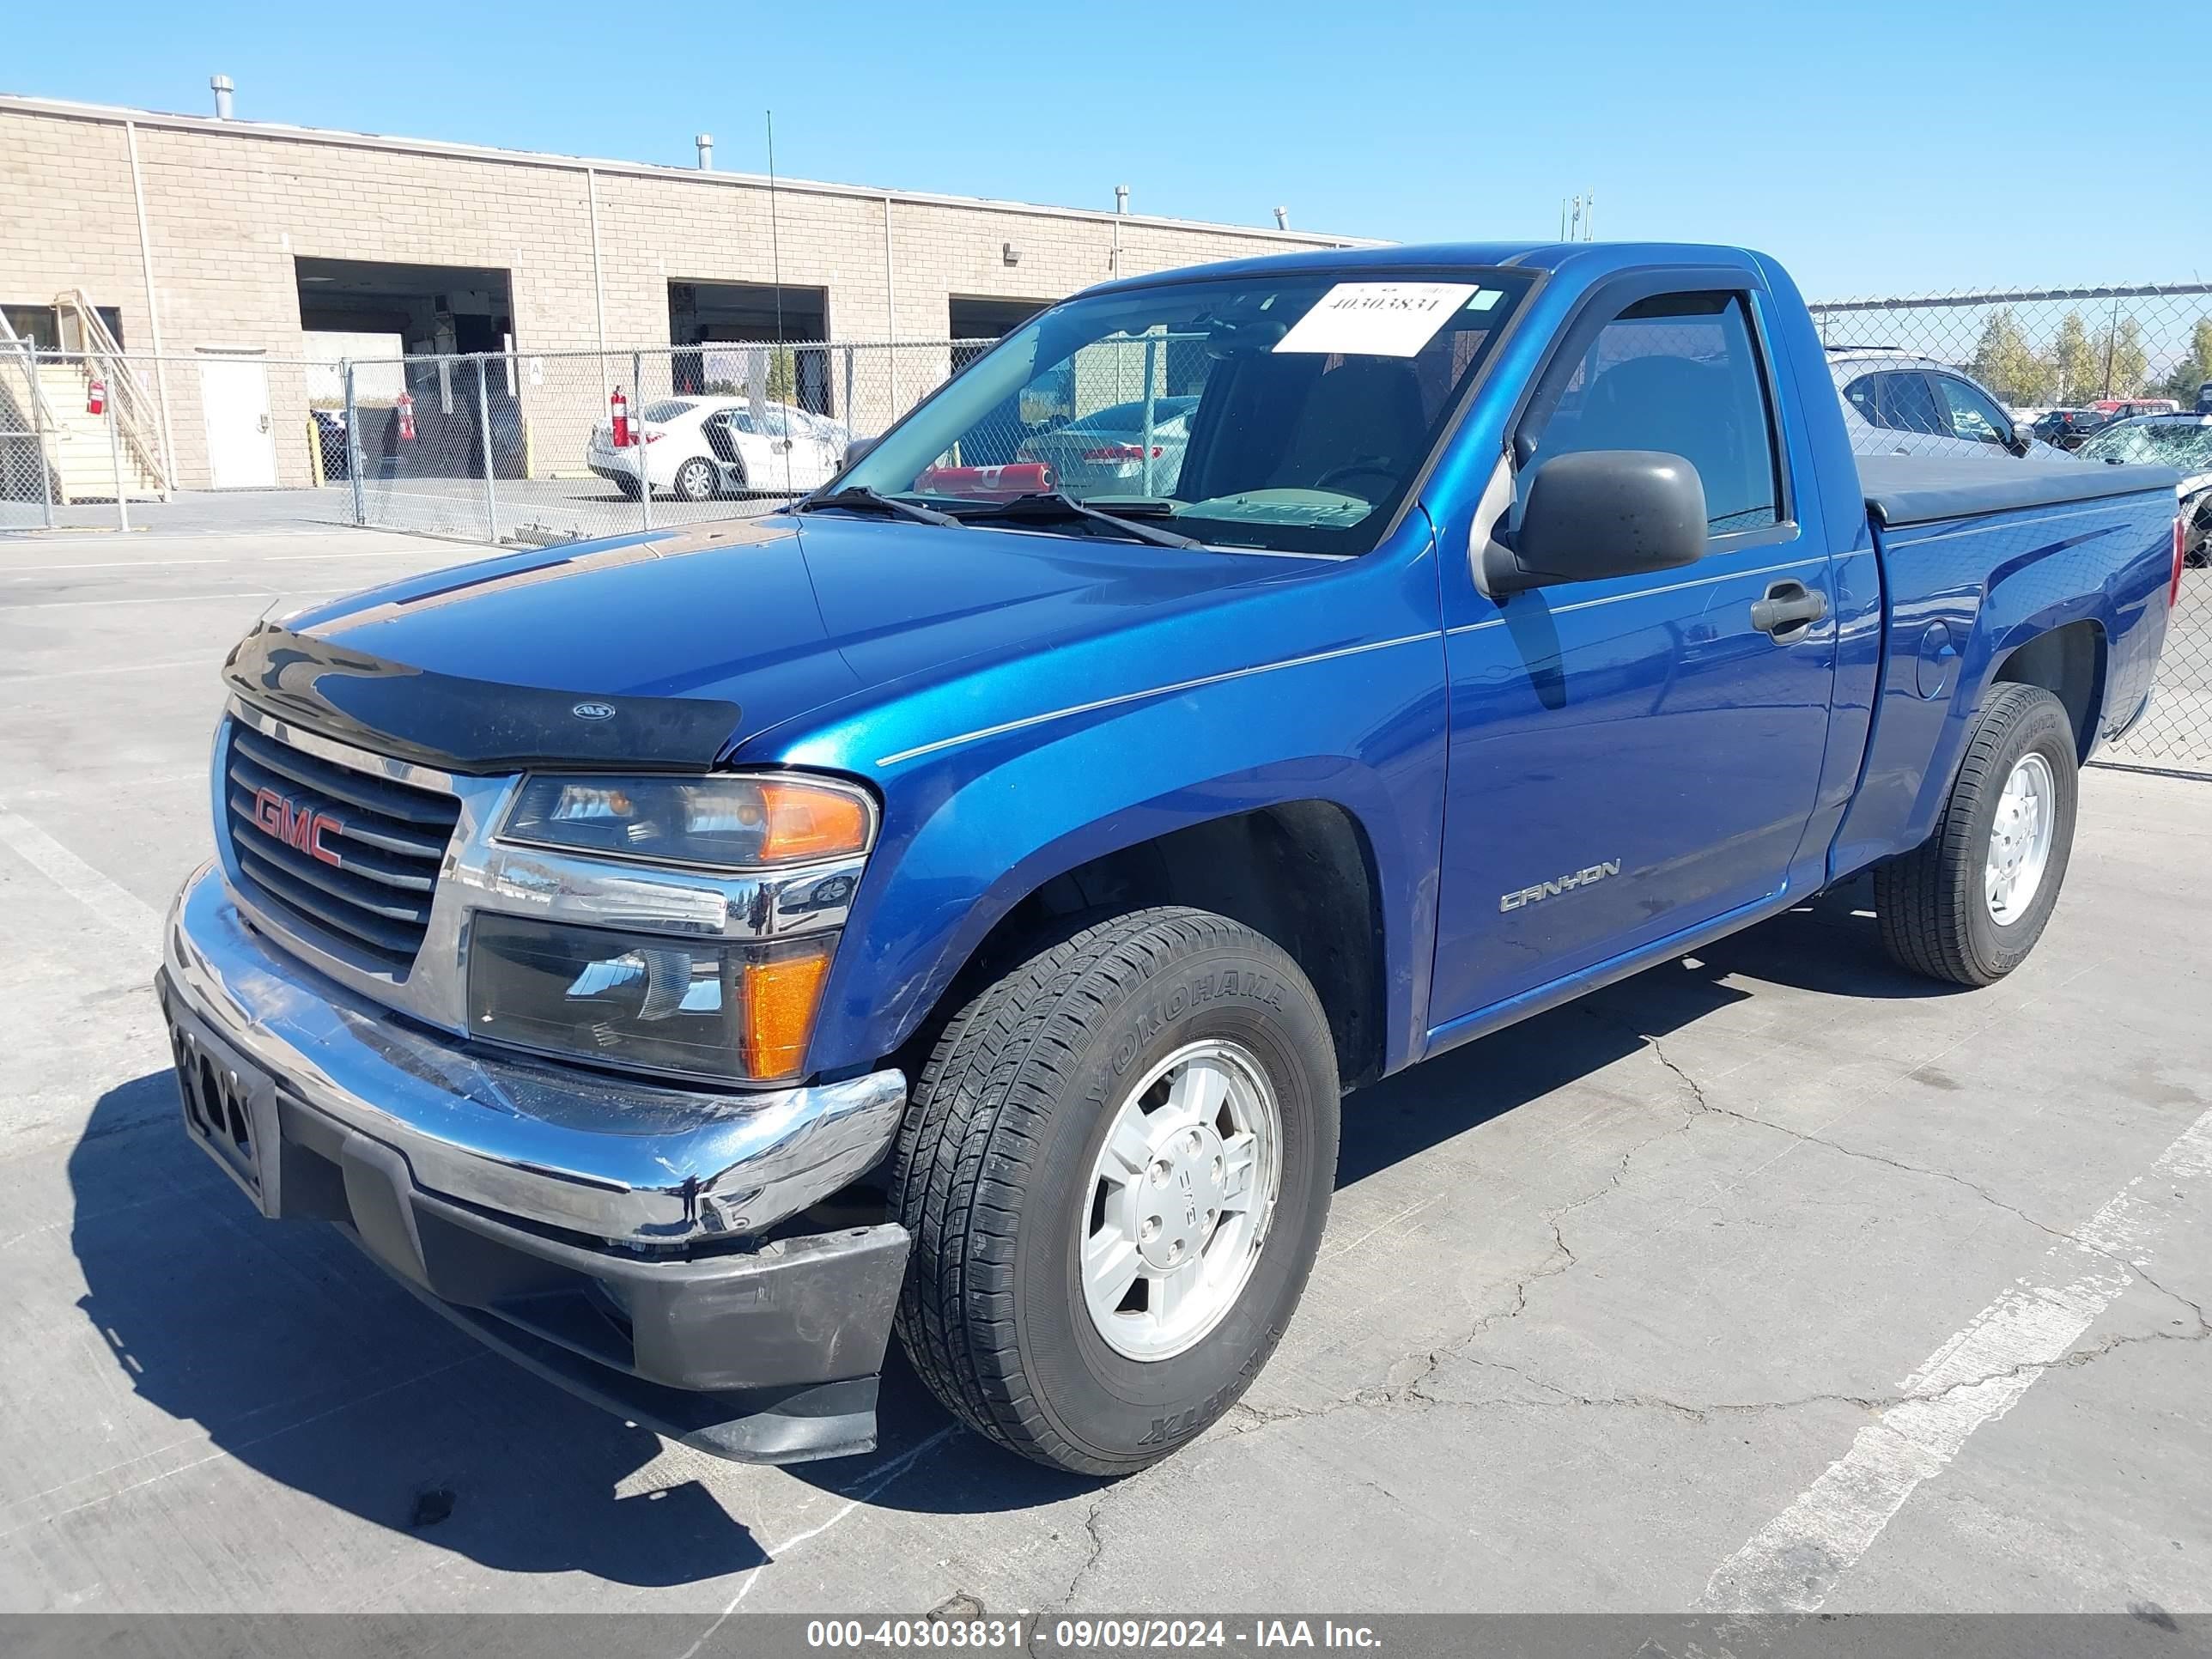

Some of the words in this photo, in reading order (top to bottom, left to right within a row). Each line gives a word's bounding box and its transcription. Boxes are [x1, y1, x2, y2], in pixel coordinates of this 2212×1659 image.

[1328, 297, 1440, 312] 40303831
[256, 787, 344, 868] GMC
[1500, 858, 1621, 913] CANYON
[1085, 969, 1286, 1107] YOKOHAMA
